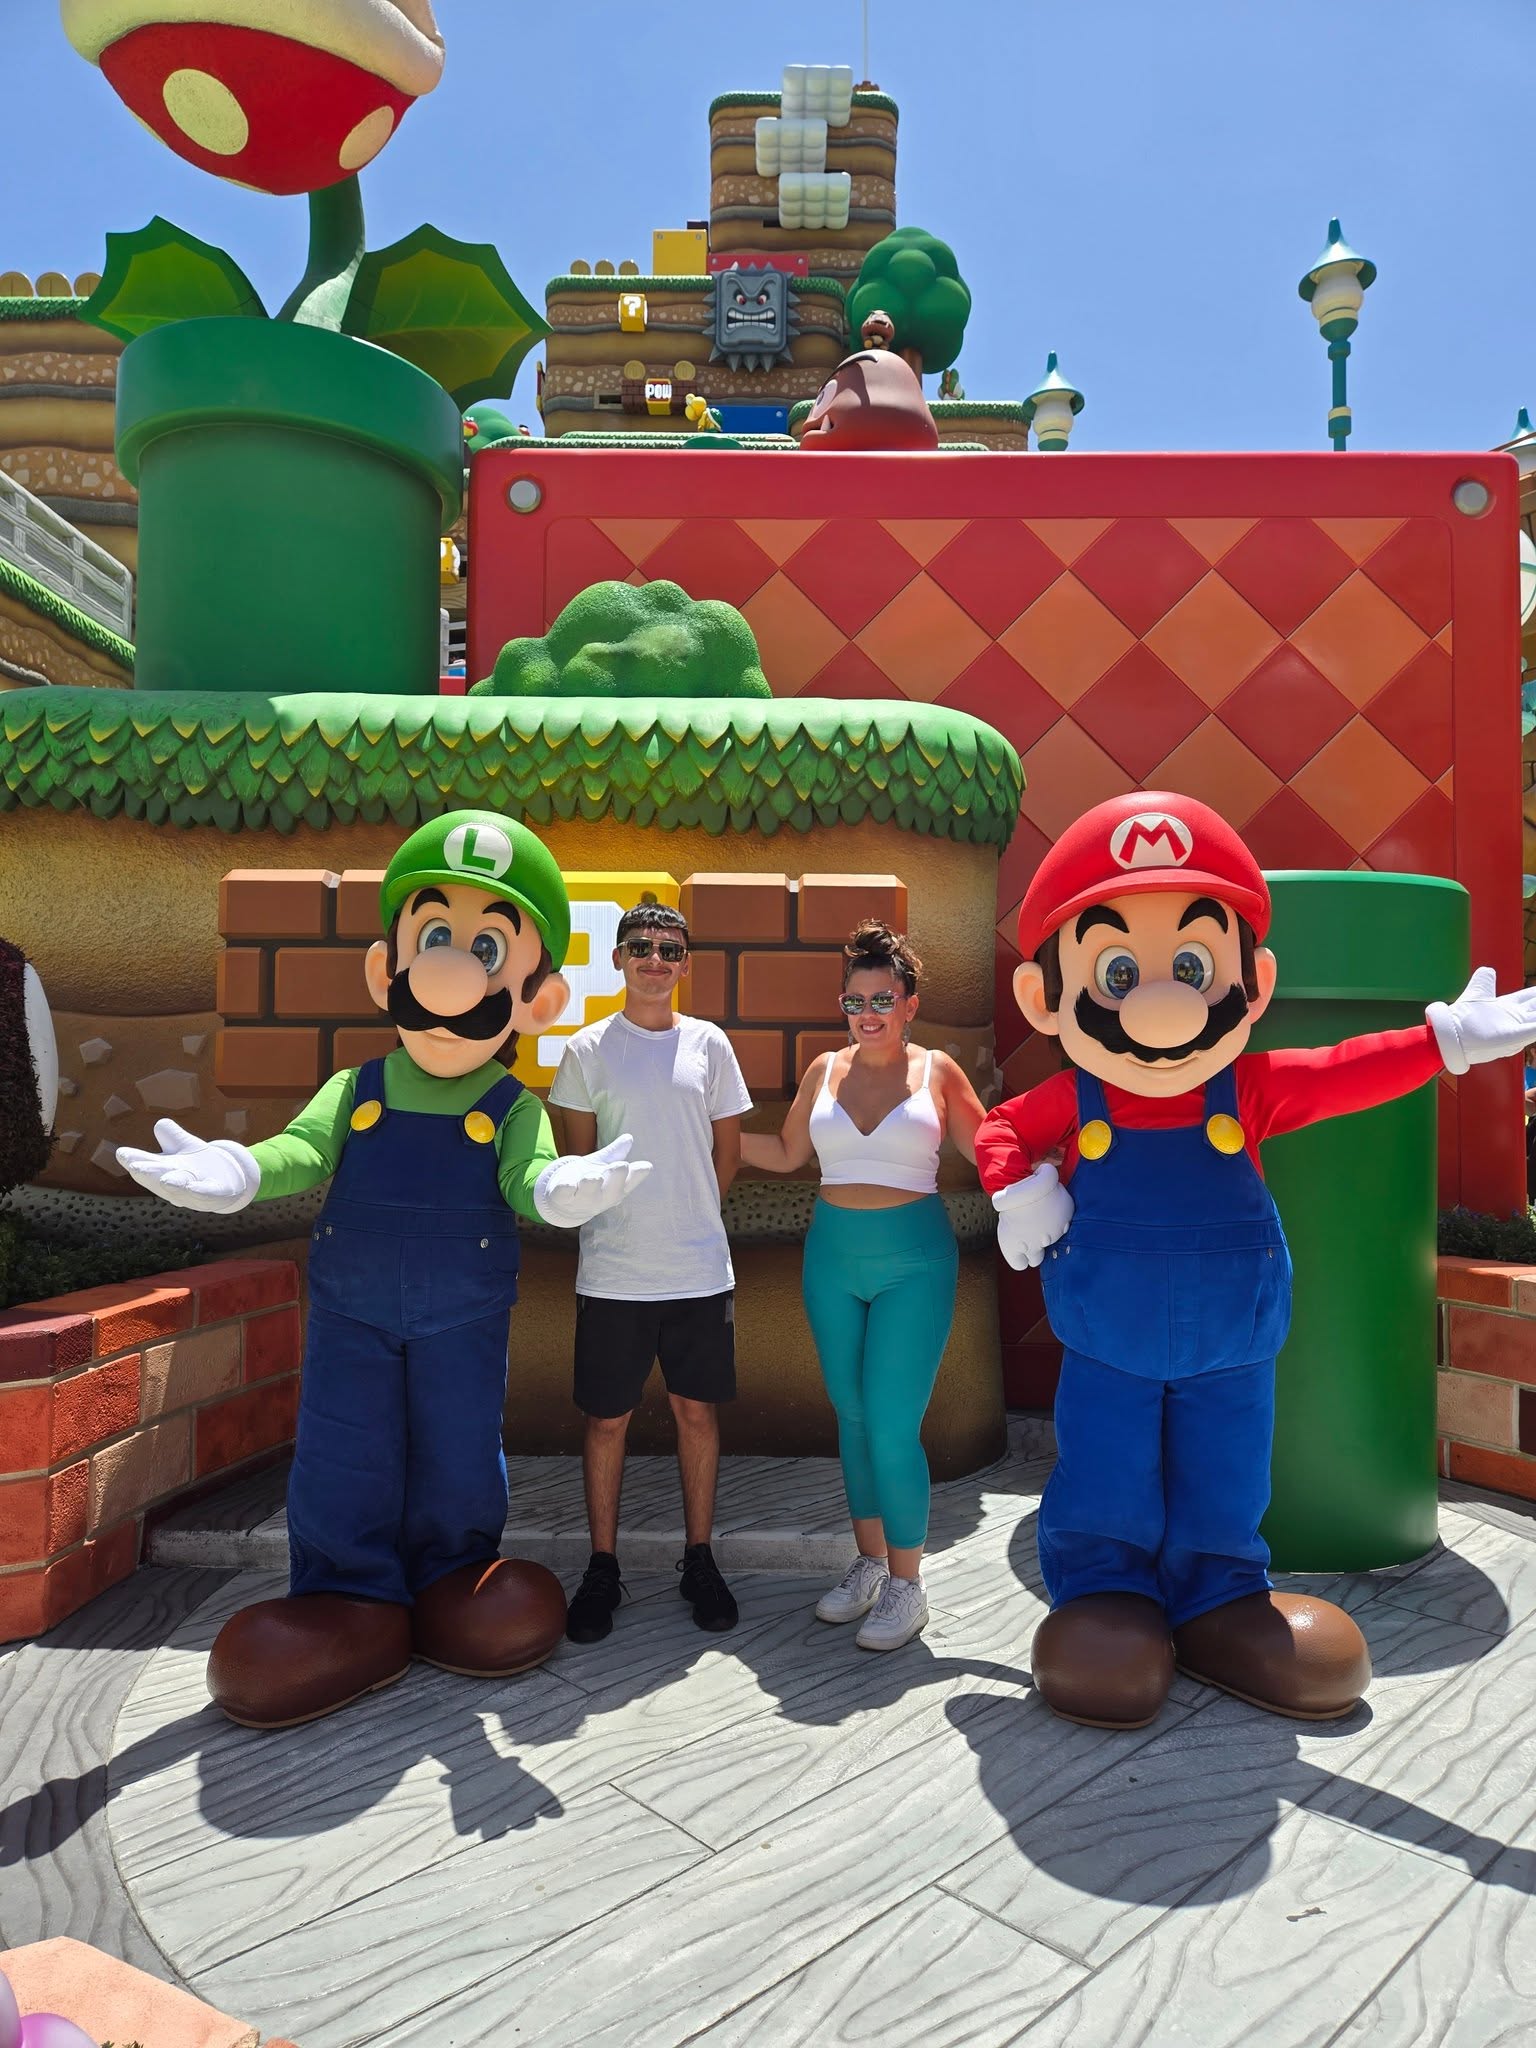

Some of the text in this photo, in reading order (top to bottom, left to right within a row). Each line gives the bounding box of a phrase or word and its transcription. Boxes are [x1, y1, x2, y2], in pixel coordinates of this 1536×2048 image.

[623, 295, 642, 317] ?
[645, 384, 672, 399] POW
[461, 827, 496, 872] L
[1118, 818, 1188, 864] M
